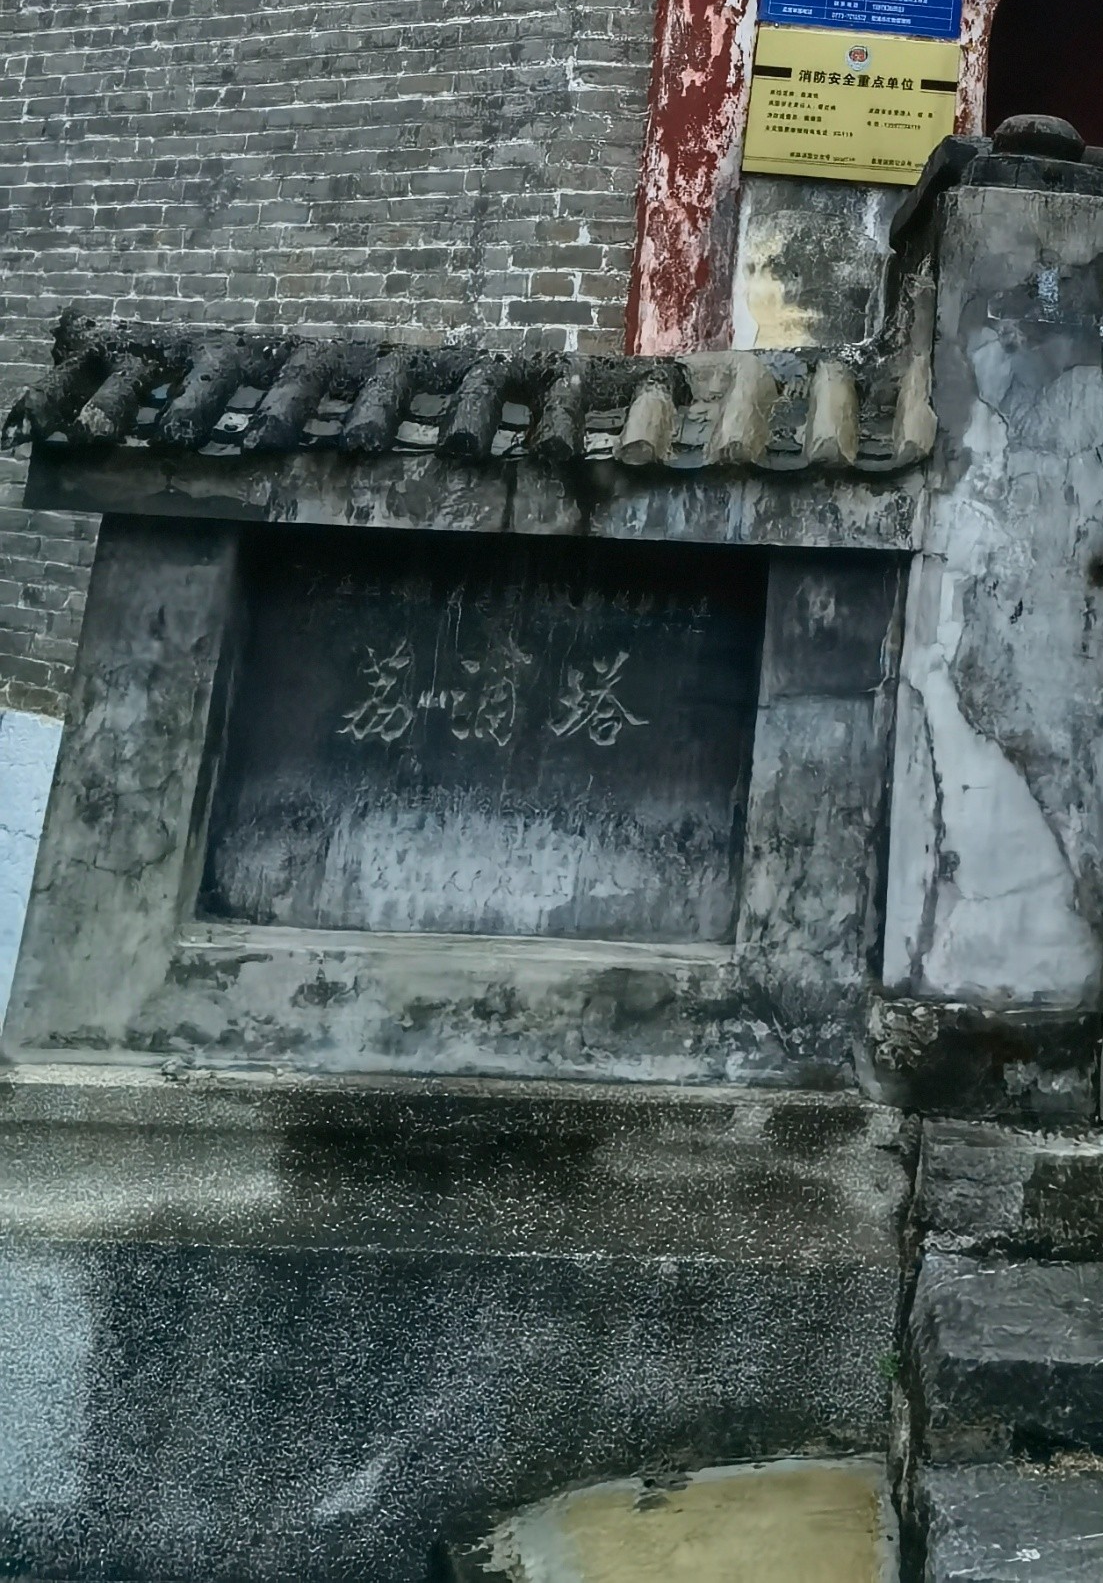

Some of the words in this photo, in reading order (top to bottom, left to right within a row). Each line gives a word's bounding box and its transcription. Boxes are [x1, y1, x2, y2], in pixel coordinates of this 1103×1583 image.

[799, 69, 914, 91] 消防安全重点单位
